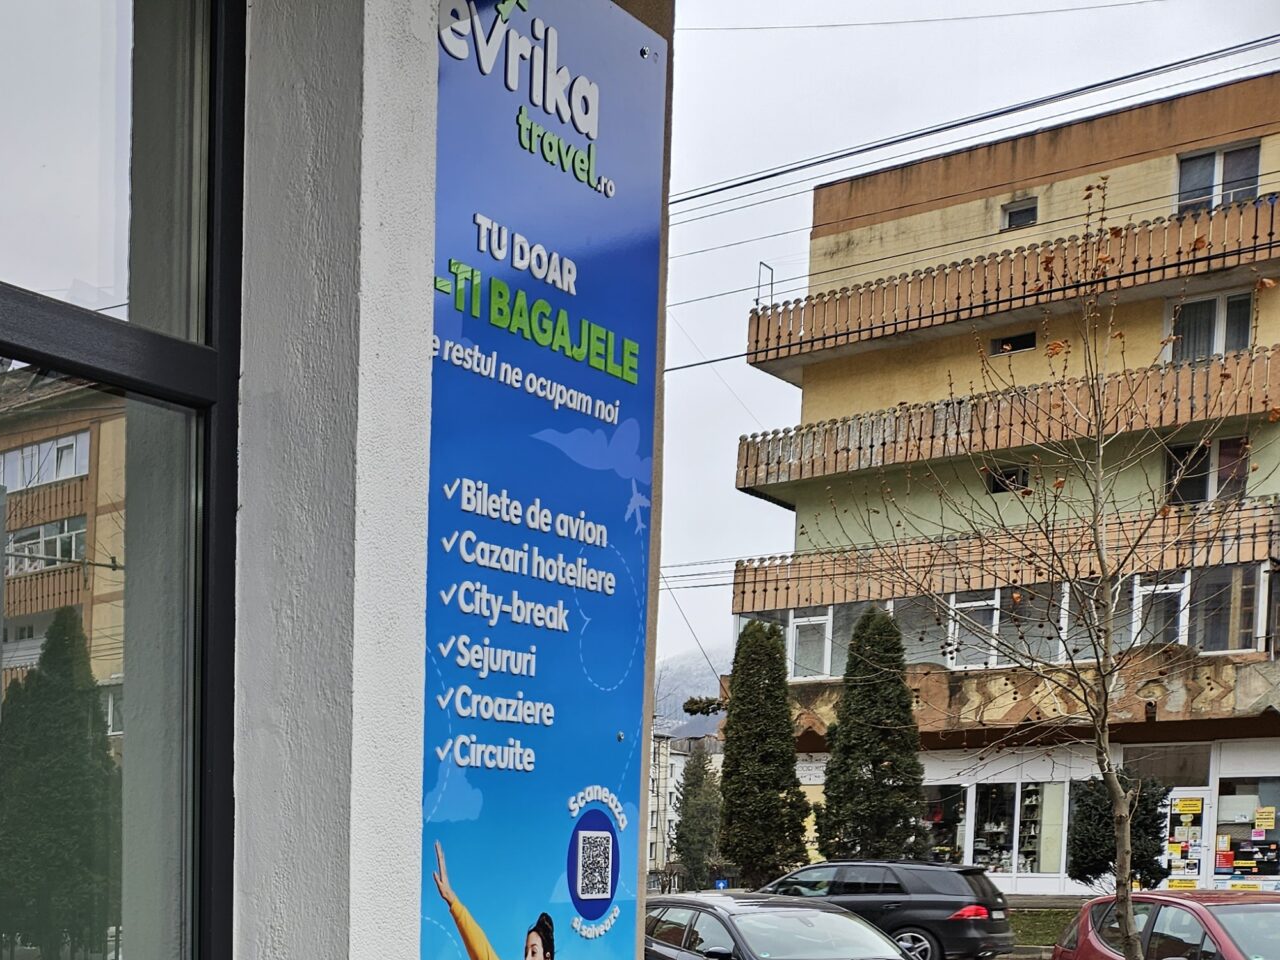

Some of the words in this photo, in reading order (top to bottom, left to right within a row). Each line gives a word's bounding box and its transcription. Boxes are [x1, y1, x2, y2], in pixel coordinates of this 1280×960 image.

[439, 0, 599, 140] evrika
[474, 213, 508, 260] TU
[512, 233, 577, 295] DOAR
[489, 276, 639, 385] BAGAJELE
[443, 338, 497, 379] restul
[499, 361, 523, 388] ne
[525, 372, 592, 410] ocupam
[594, 400, 620, 425] noi
[461, 478, 521, 526] Bilete
[526, 497, 552, 533] de
[555, 509, 608, 548] avion
[459, 530, 529, 574] Cazari
[532, 545, 616, 596] hoteliere
[458, 580, 569, 632] City-break
[456, 635, 537, 679] Sejururi
[455, 685, 555, 727] Croaziere
[453, 735, 536, 773] Circuite
[568, 785, 628, 831] Scaneaza
